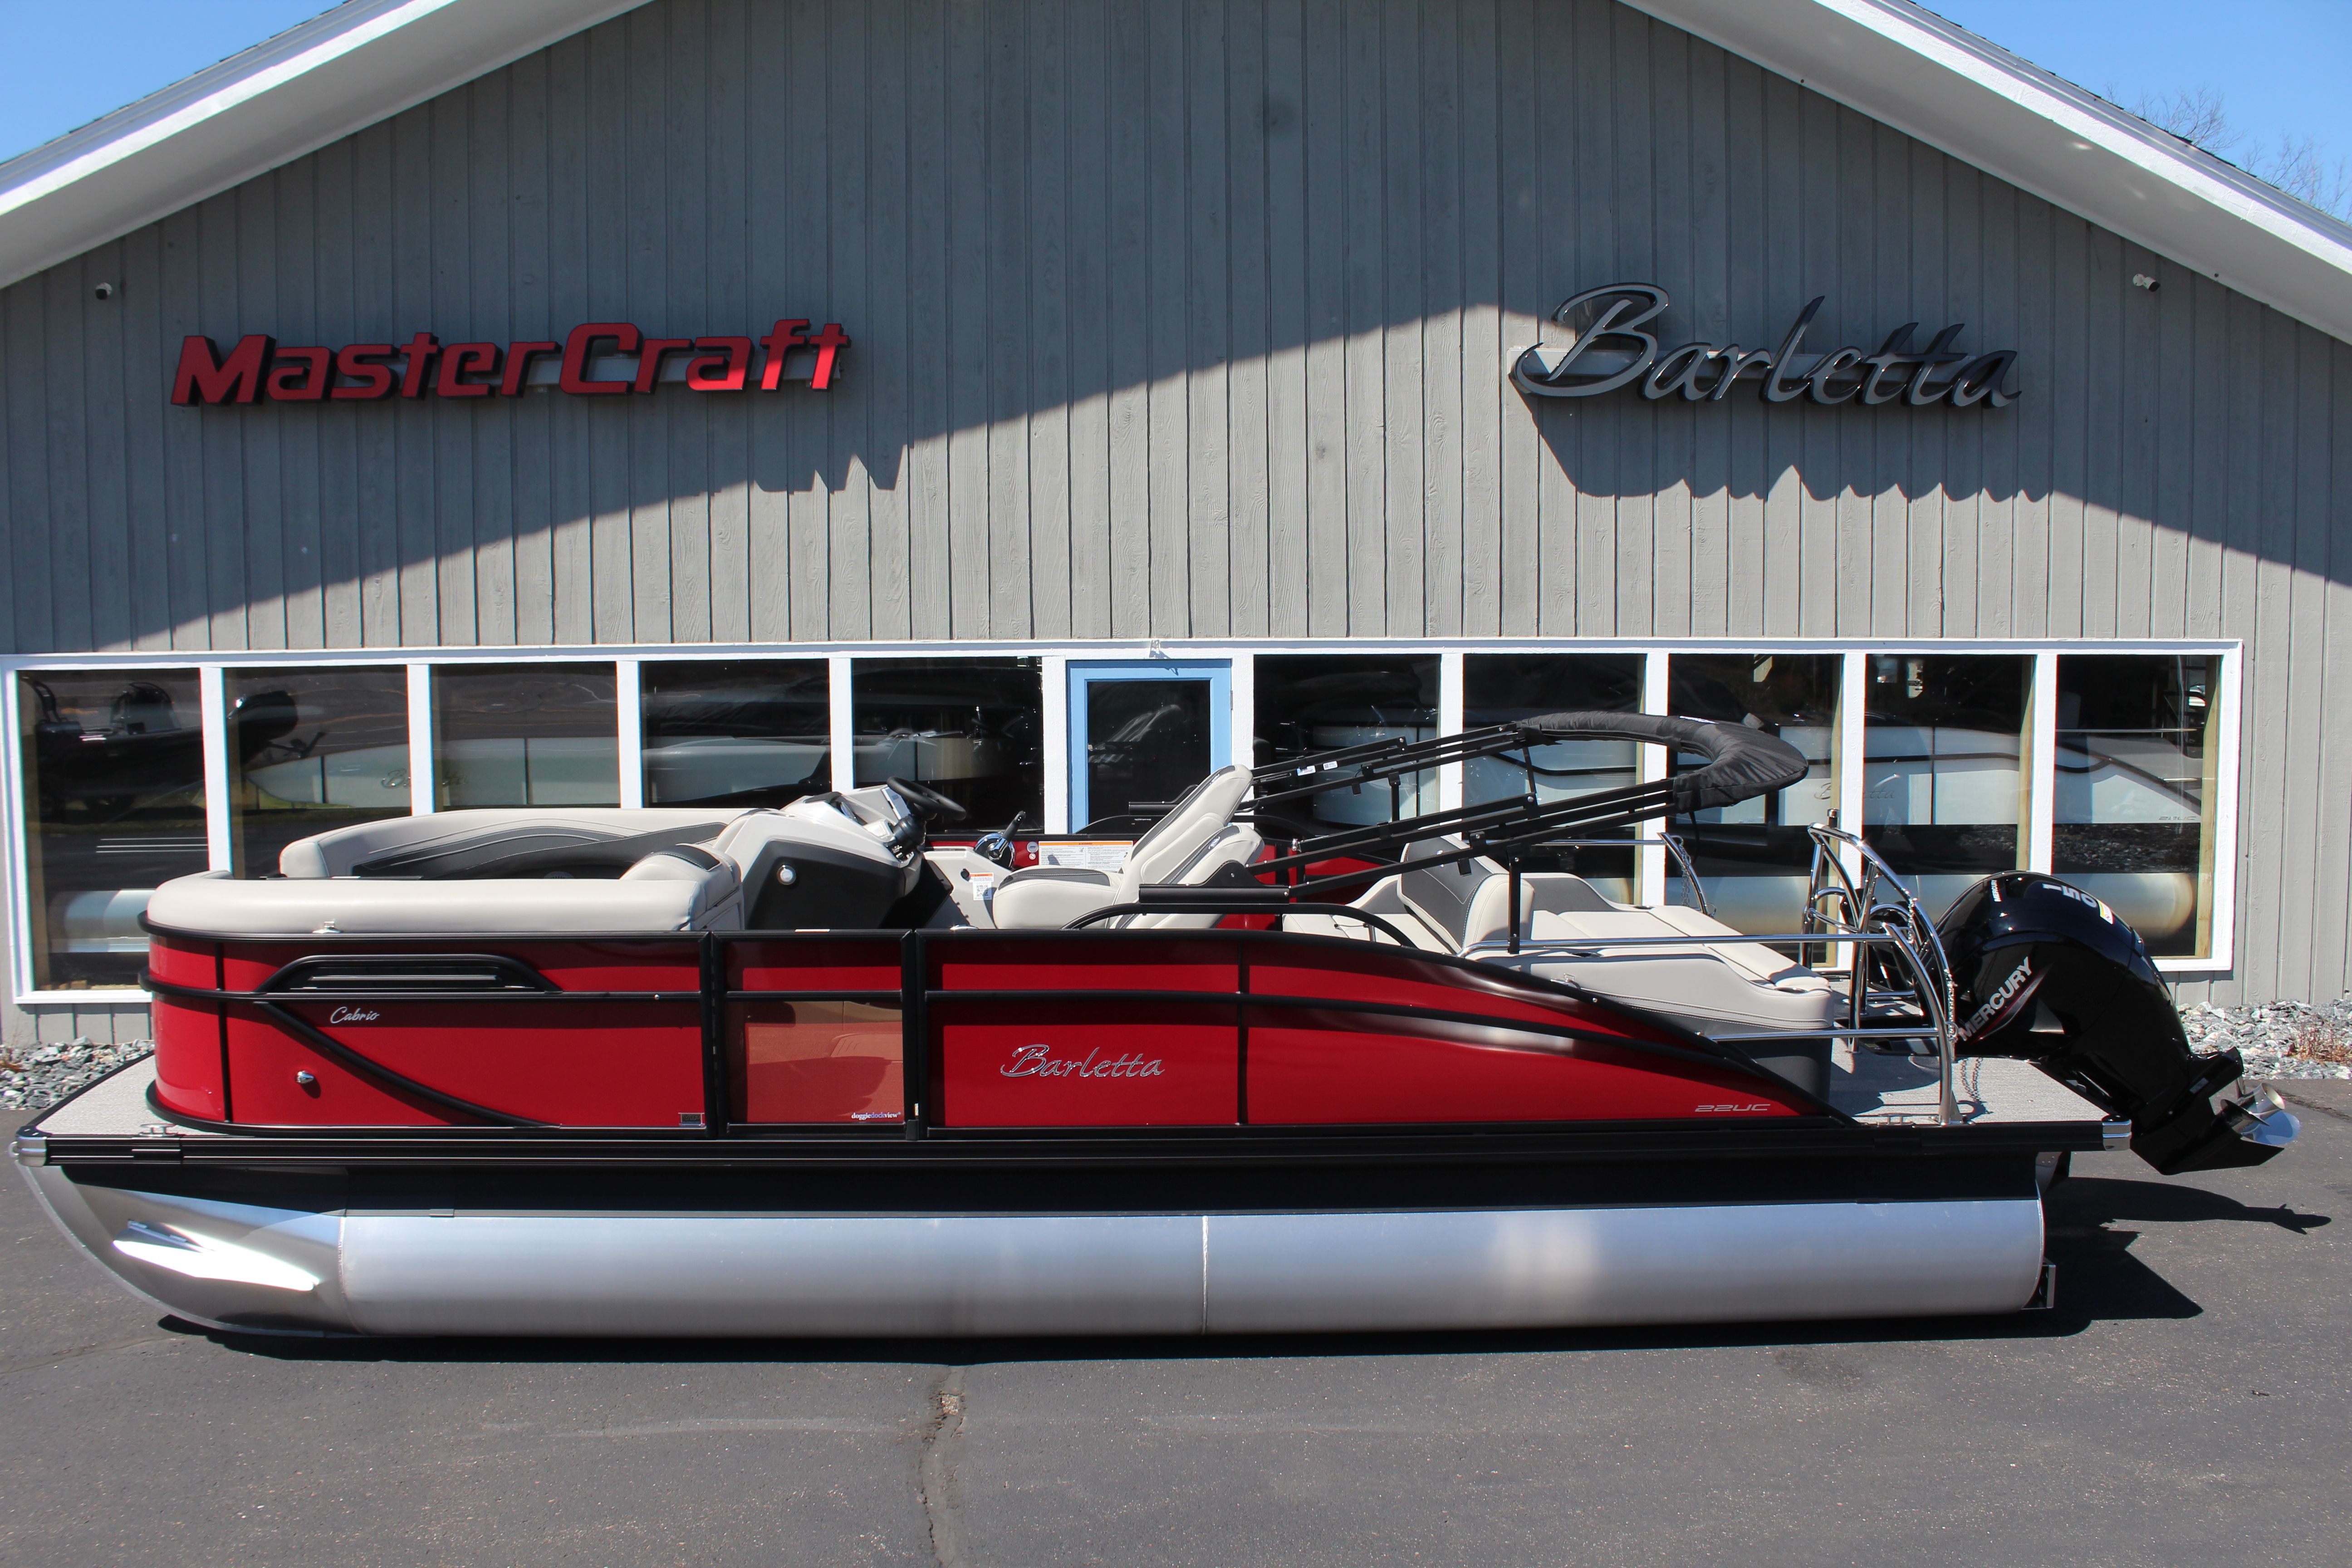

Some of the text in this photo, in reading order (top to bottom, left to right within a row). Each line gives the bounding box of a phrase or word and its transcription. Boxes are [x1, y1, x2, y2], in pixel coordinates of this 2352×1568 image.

[1508, 282, 2022, 407] Barletta
[171, 318, 851, 406] MasterCraft
[2042, 883, 2097, 908] 150
[330, 1006, 380, 1024] Cabrio
[1958, 956, 2032, 1042] MERCURY
[1000, 1044, 1165, 1078] Barletta
[1695, 1104, 1771, 1112] 22UC
